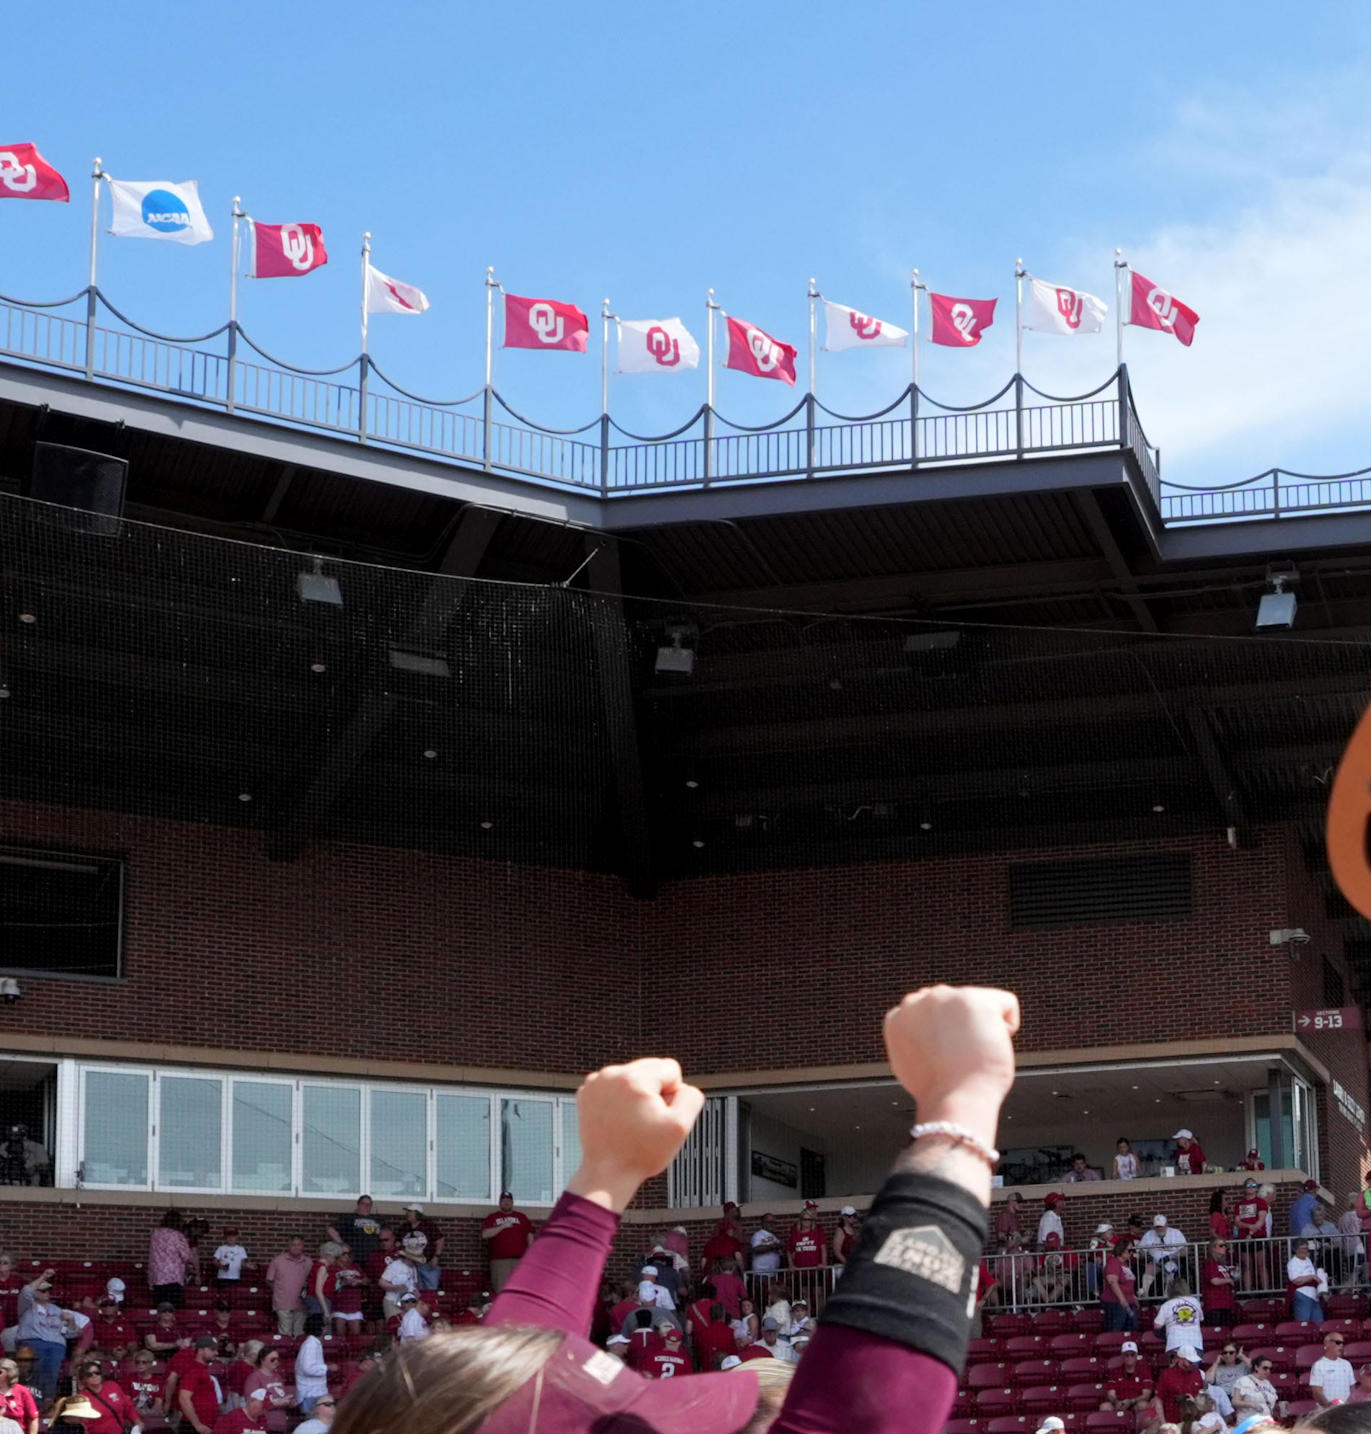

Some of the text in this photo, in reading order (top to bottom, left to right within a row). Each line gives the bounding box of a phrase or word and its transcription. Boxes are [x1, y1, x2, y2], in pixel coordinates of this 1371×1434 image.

[147, 212, 192, 226] NCAA
[281, 223, 314, 271] OU
[529, 303, 564, 343] OU
[951, 303, 977, 342] OU
[1056, 288, 1083, 329] OU
[647, 326, 680, 366] OU
[747, 329, 784, 372] OU
[1314, 1015, 1343, 1029] 9-13
